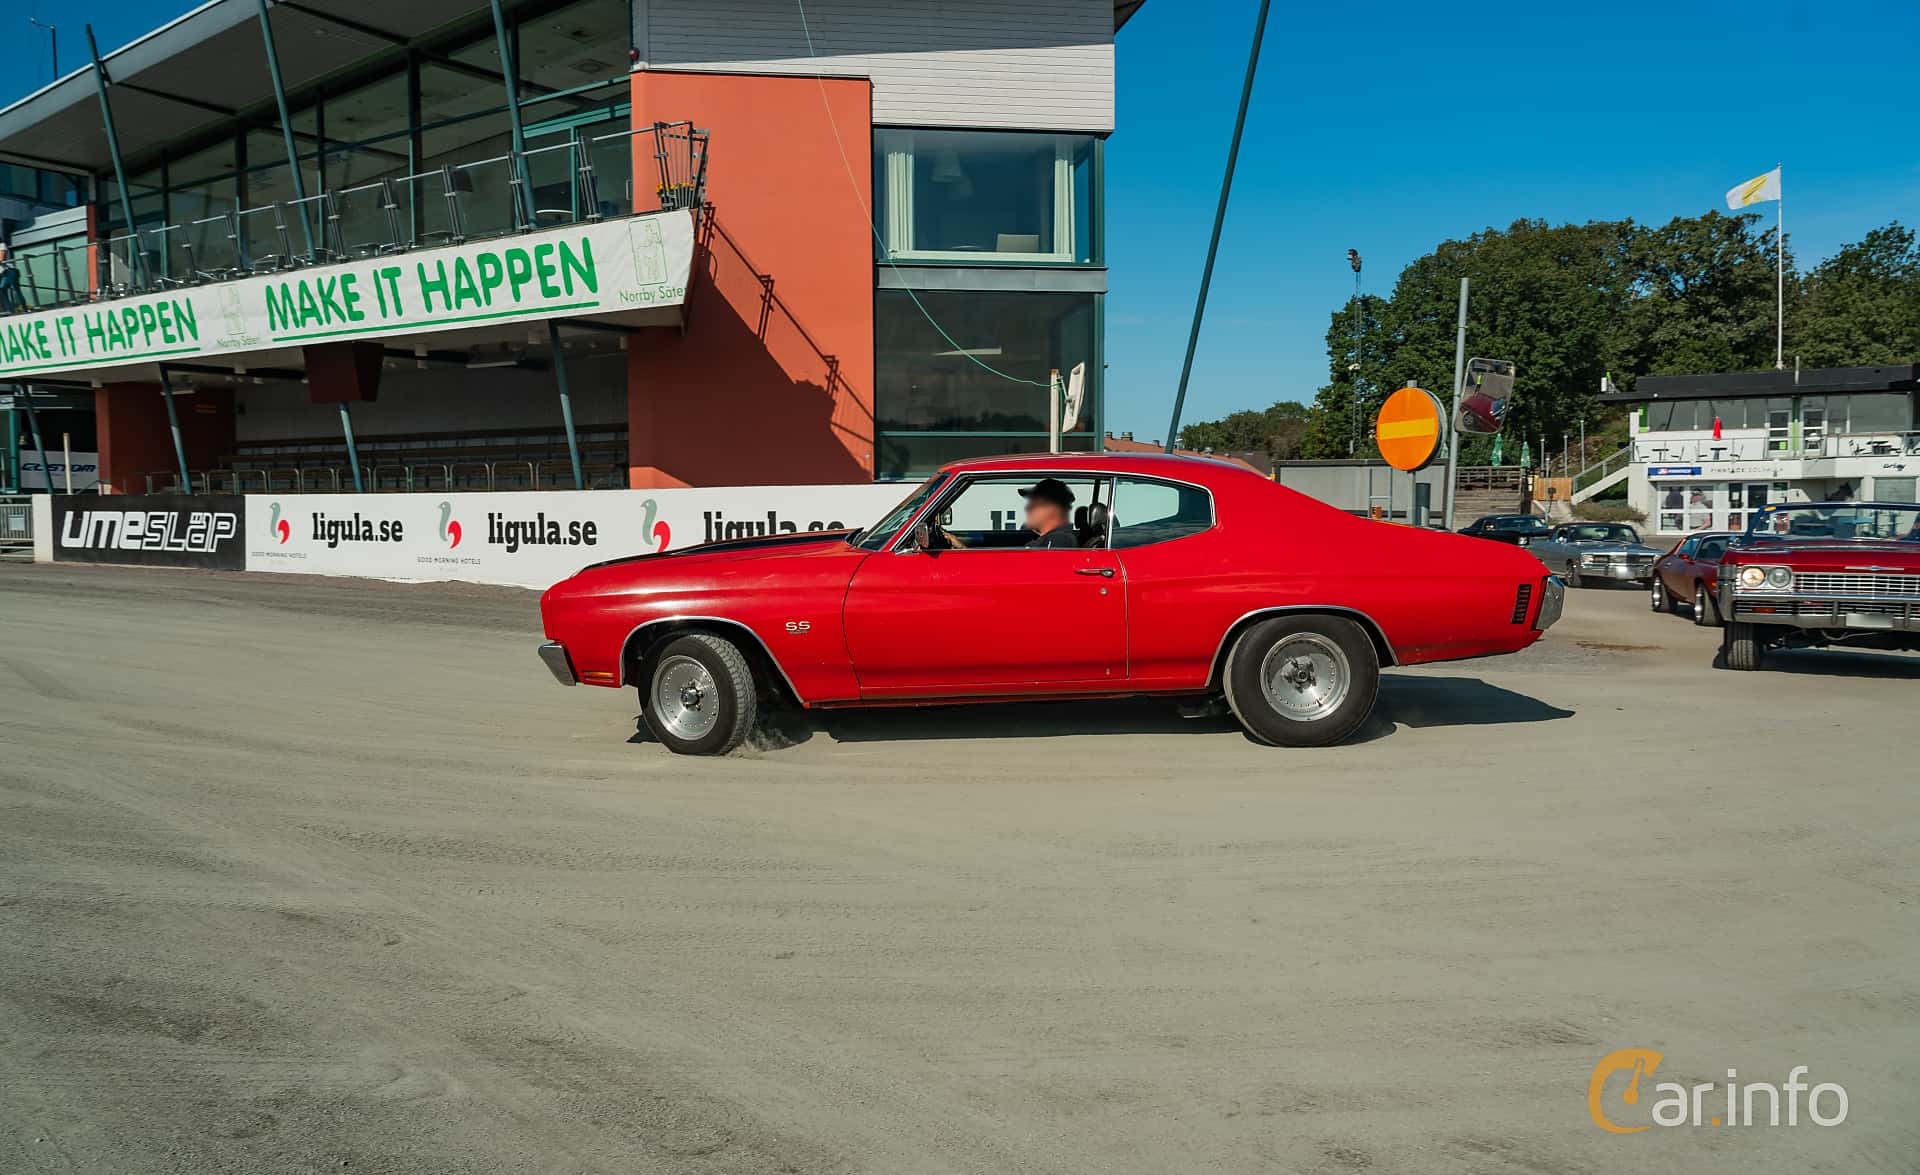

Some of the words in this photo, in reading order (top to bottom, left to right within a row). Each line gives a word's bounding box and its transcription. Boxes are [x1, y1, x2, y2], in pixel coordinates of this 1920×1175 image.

[264, 272, 366, 333] MAKE
[372, 266, 404, 319] IT
[416, 236, 599, 314] HAPPEN
[619, 288, 656, 303] Norrby
[54, 315, 78, 357] IT
[83, 297, 200, 353] HAPPEN
[312, 512, 404, 549] ligula.se
[487, 512, 598, 554] ligula.se
[703, 510, 846, 544] ligula
[785, 620, 811, 631] SS
